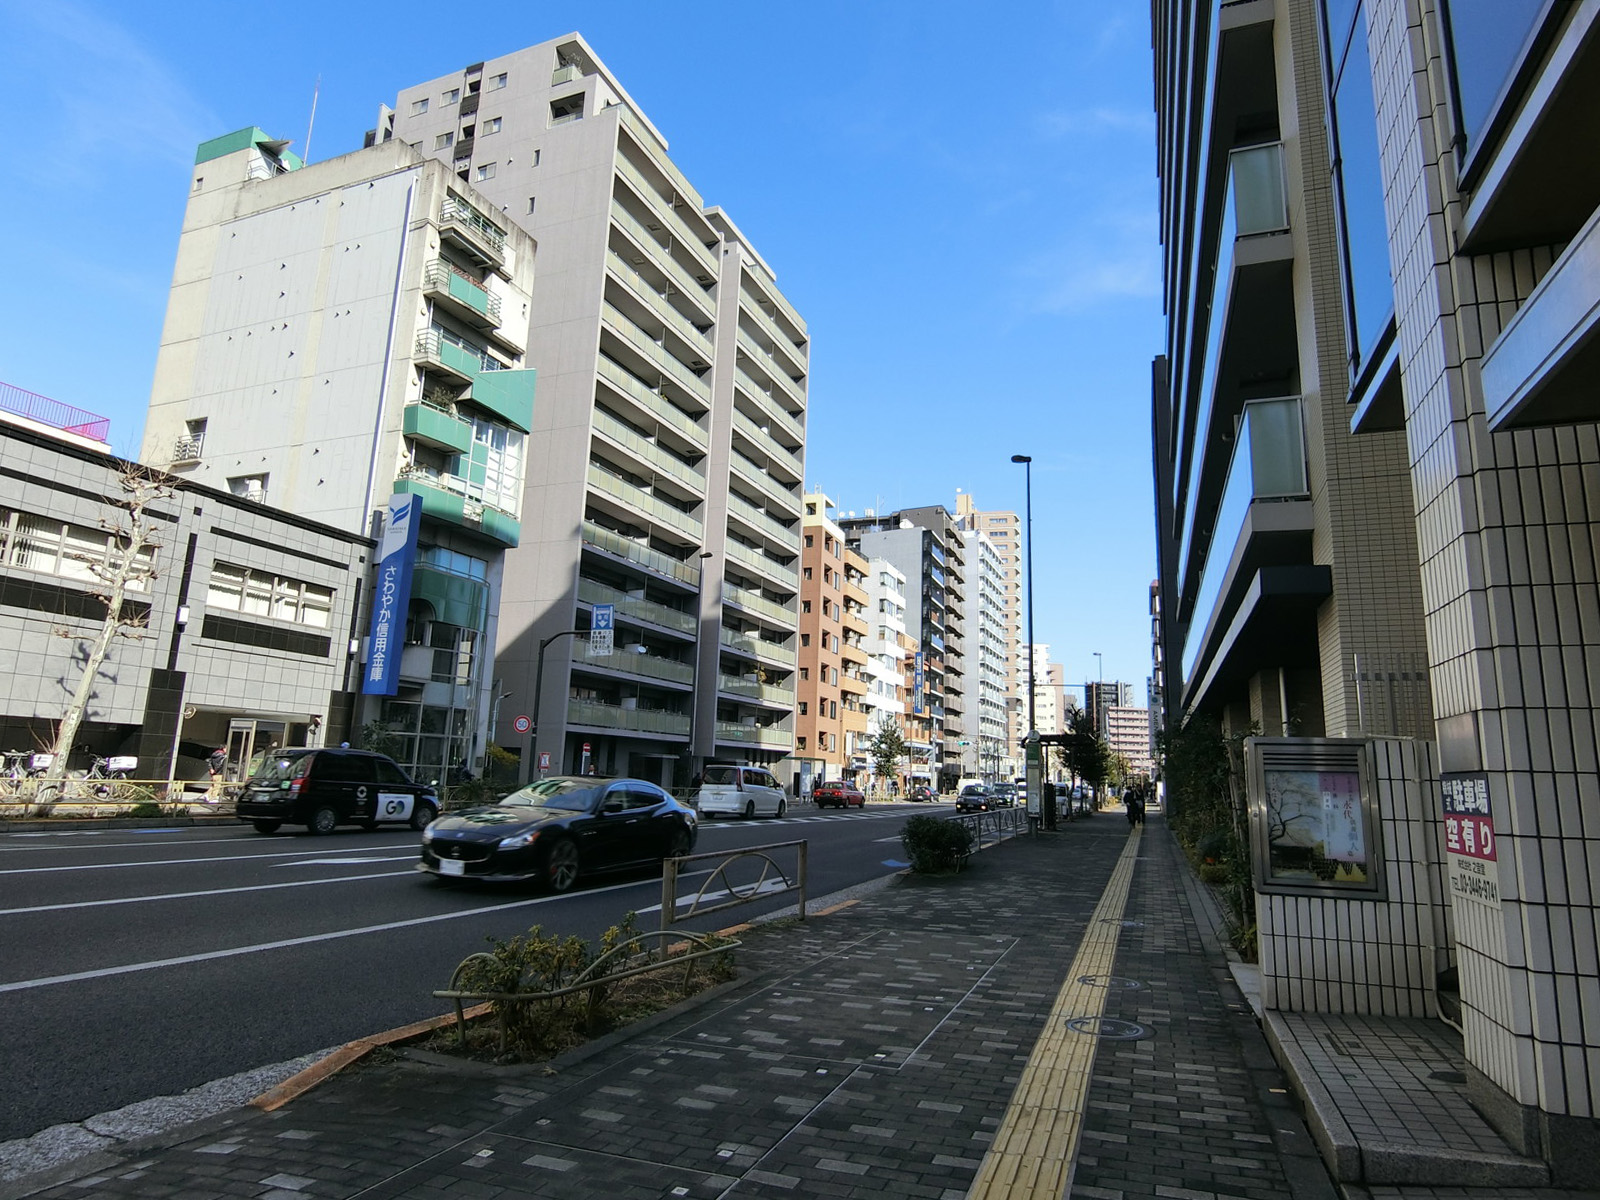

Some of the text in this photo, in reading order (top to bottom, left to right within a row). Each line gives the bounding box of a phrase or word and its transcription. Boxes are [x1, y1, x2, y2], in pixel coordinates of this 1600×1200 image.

[369, 565, 397, 682] さわやか信用金庫
[517, 720, 527, 728] 50
[385, 800, 405, 815] GO
[1452, 779, 1489, 814] 駐車場
[1446, 817, 1493, 855] 空有り
